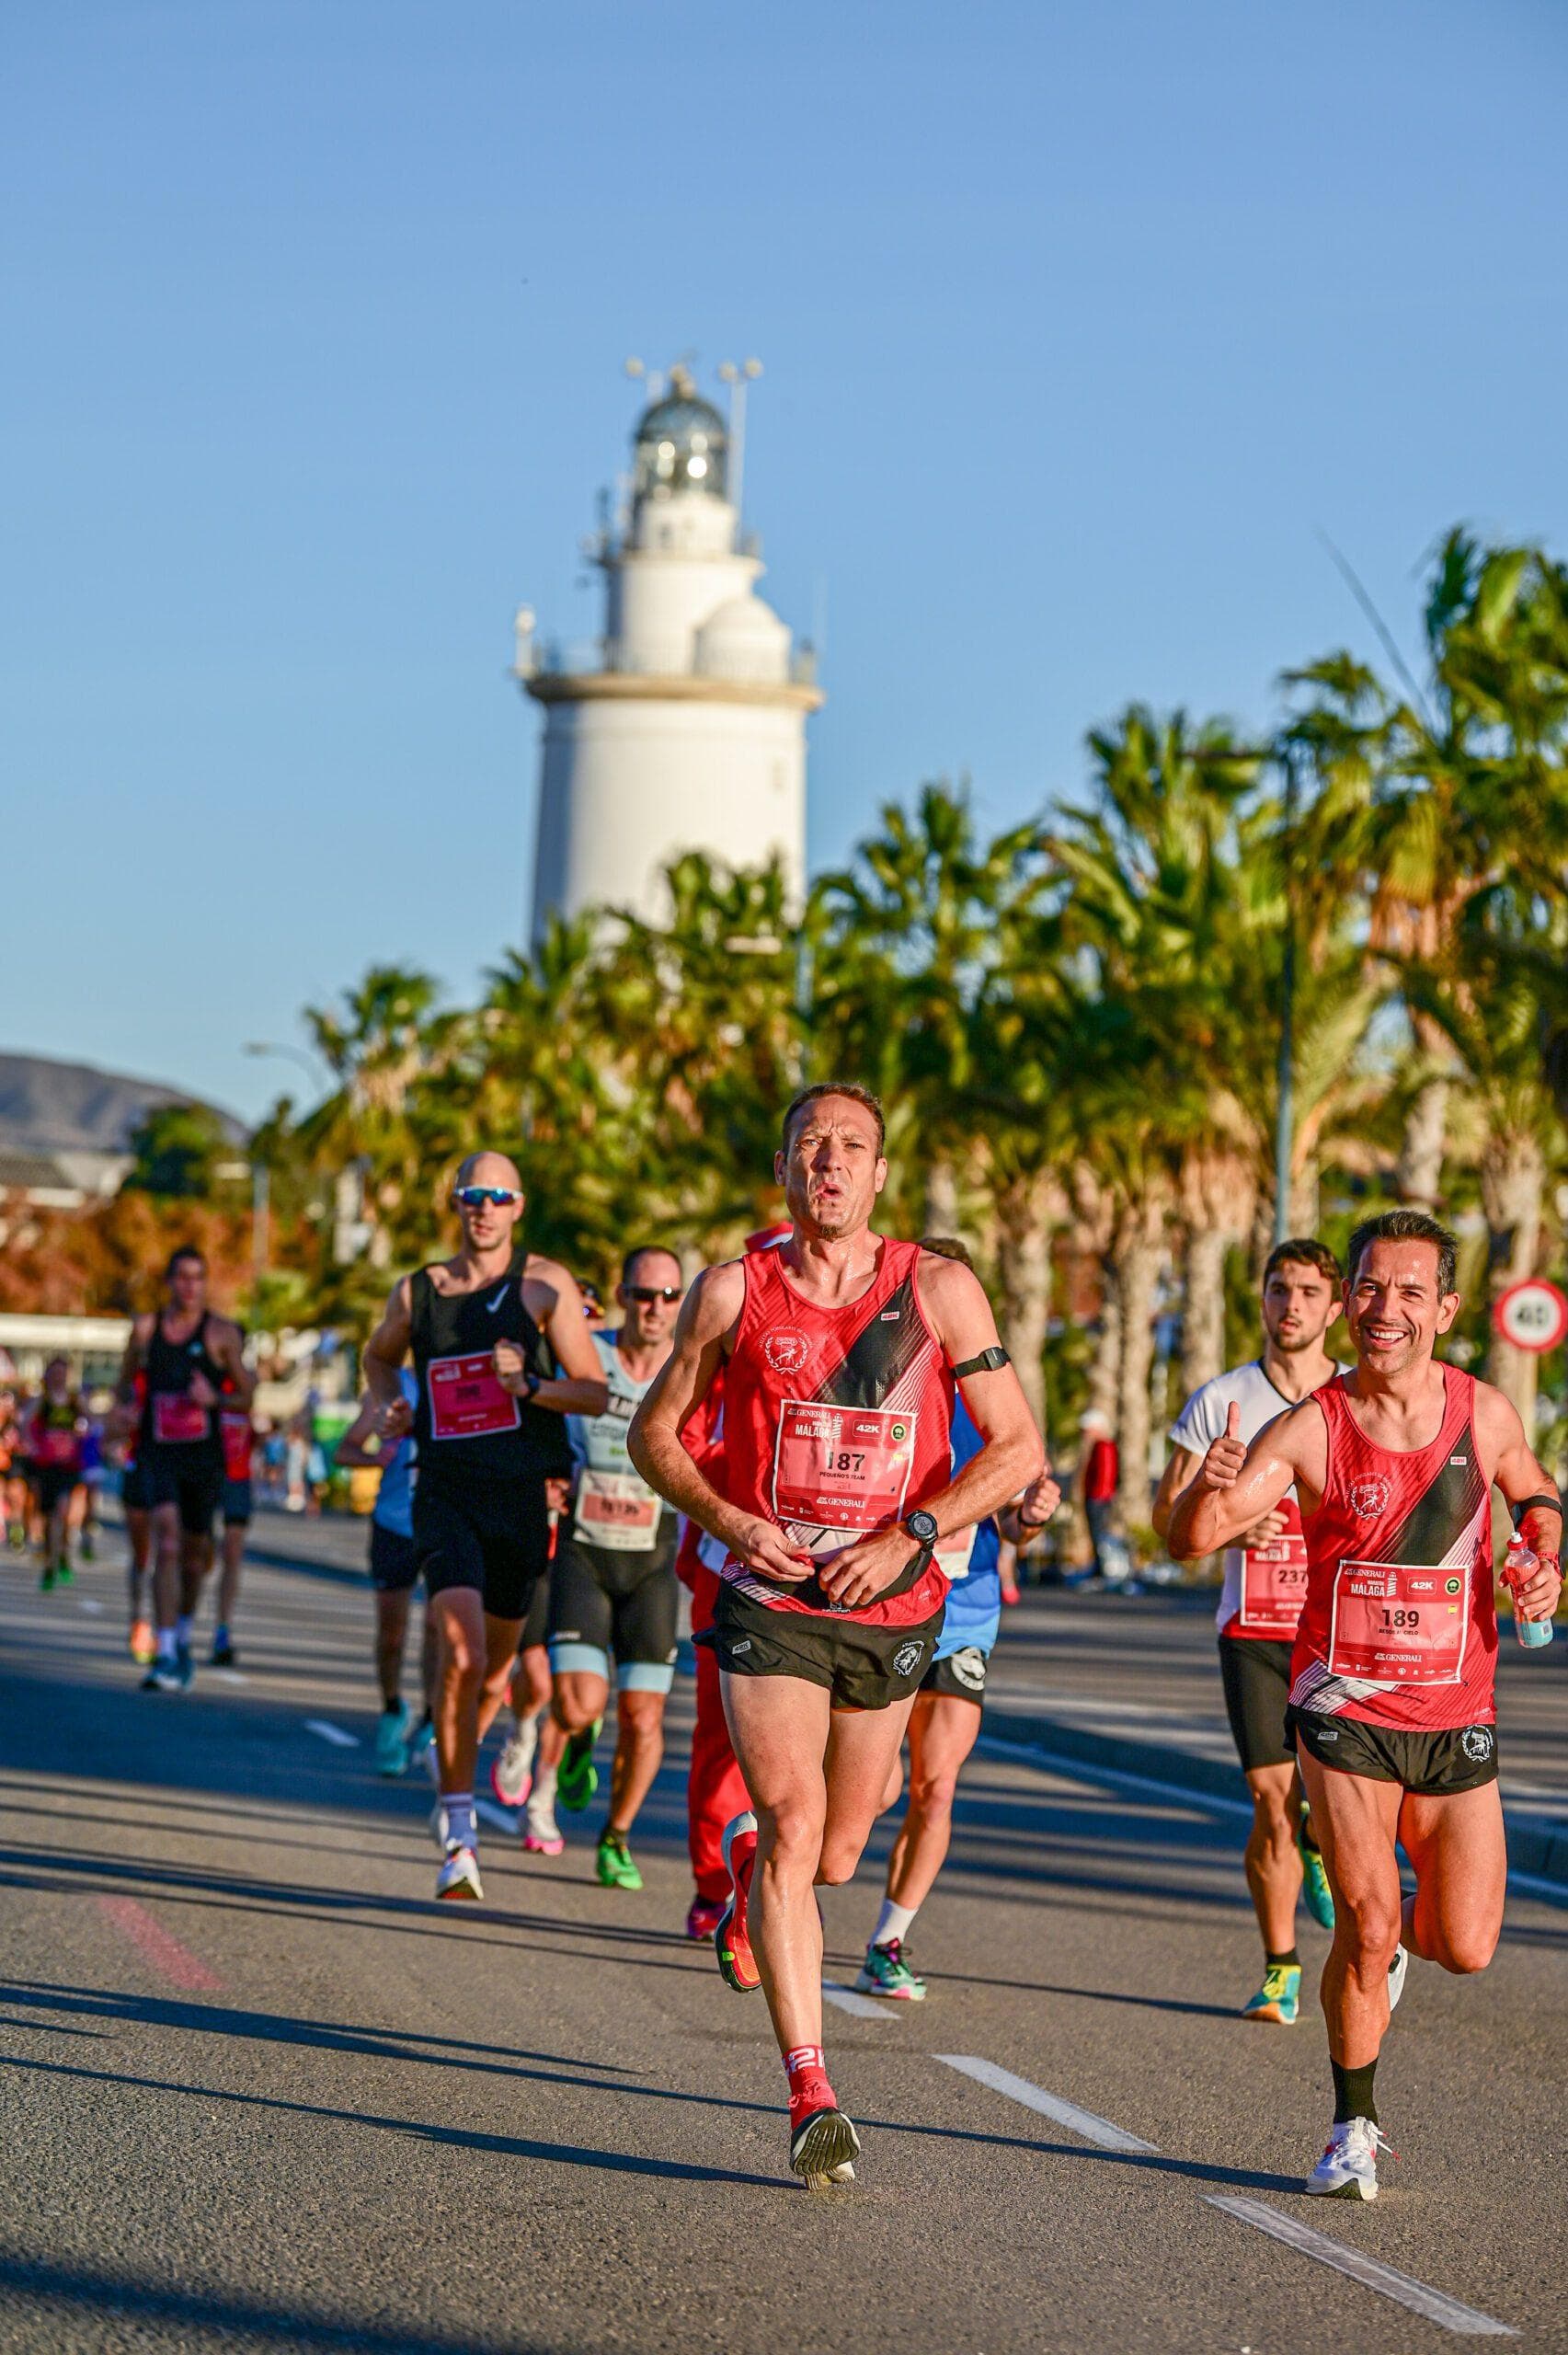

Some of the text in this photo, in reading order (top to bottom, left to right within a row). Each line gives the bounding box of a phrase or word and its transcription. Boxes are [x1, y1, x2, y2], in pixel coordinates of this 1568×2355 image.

[856, 1424, 880, 1434] 42K
[828, 1451, 865, 1472] 187
[828, 1497, 865, 1509] GENERALI
[1278, 1569, 1307, 1583] 237
[1351, 1582, 1385, 1597] MÁLAGA
[1411, 1580, 1434, 1591] 42K
[1381, 1609, 1420, 1628] 189
[1386, 1653, 1422, 1663] GENERALI
